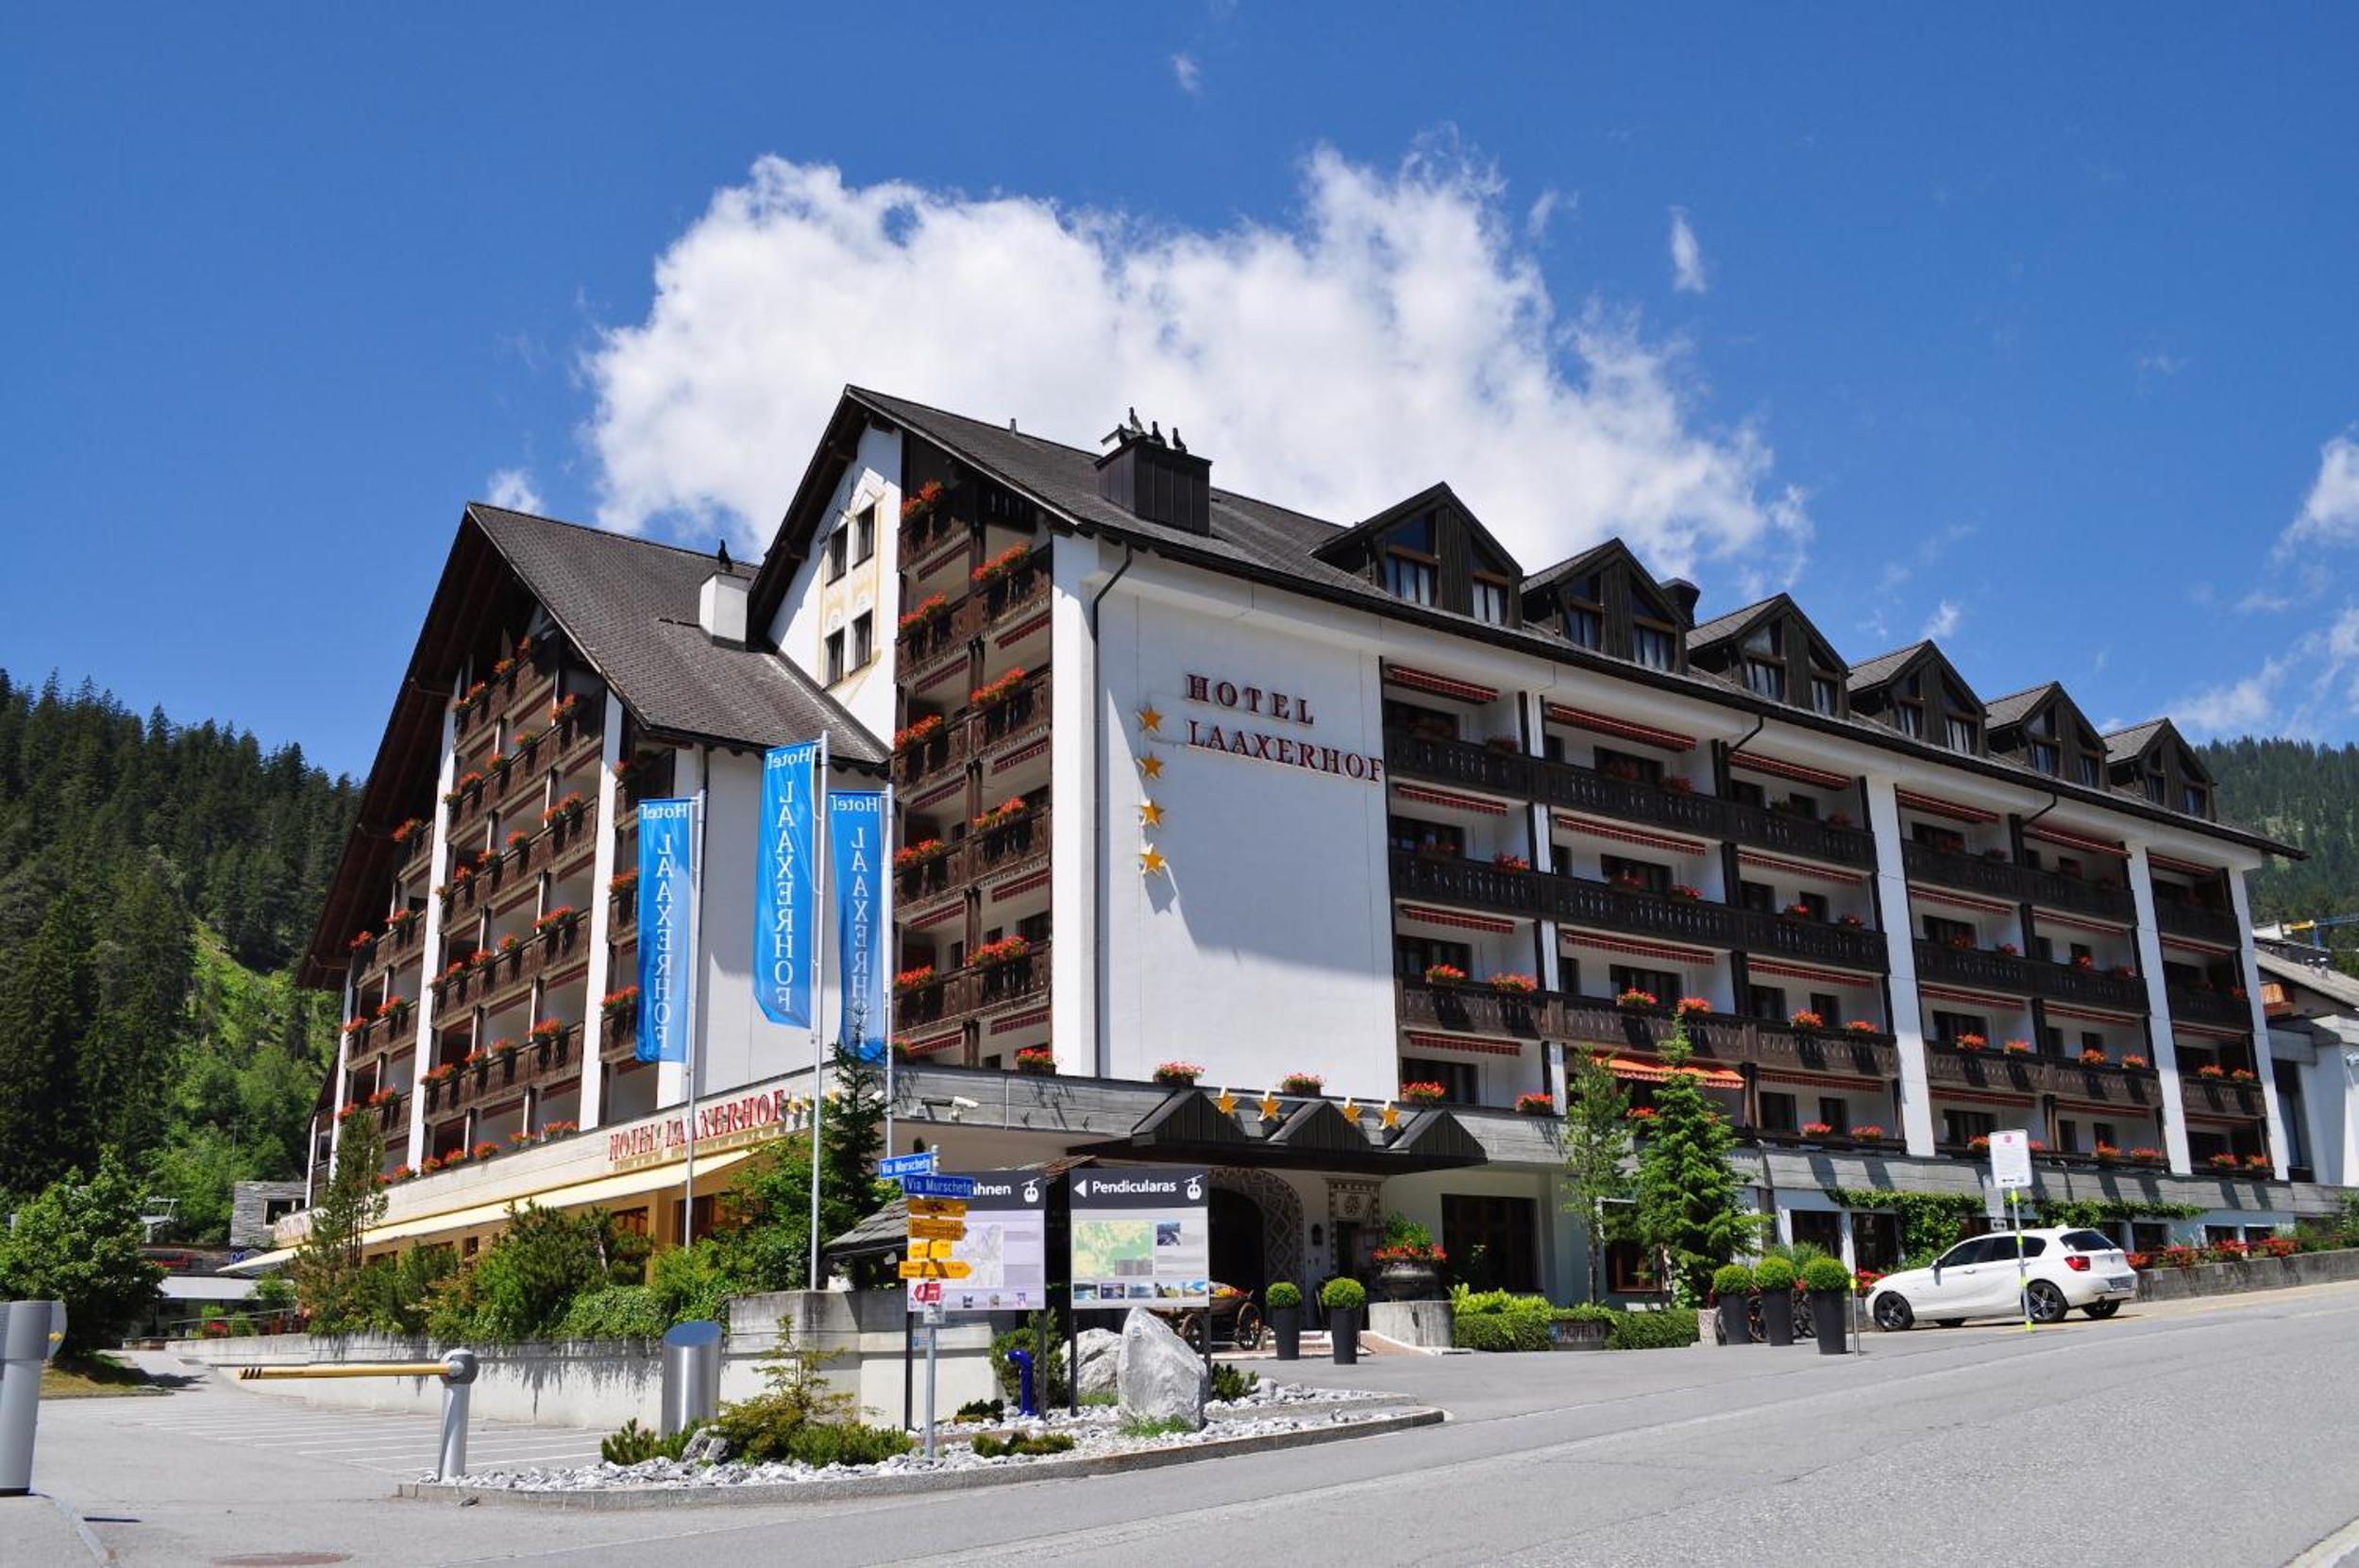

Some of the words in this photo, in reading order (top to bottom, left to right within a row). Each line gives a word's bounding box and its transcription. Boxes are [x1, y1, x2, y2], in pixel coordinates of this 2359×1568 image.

[1187, 674, 1313, 724] HOTEL
[1188, 719, 1383, 782] LAAXERHOF
[609, 1122, 658, 1161] HOTEL
[906, 1177, 921, 1190] Via
[1092, 1179, 1177, 1193] Pendicularas
